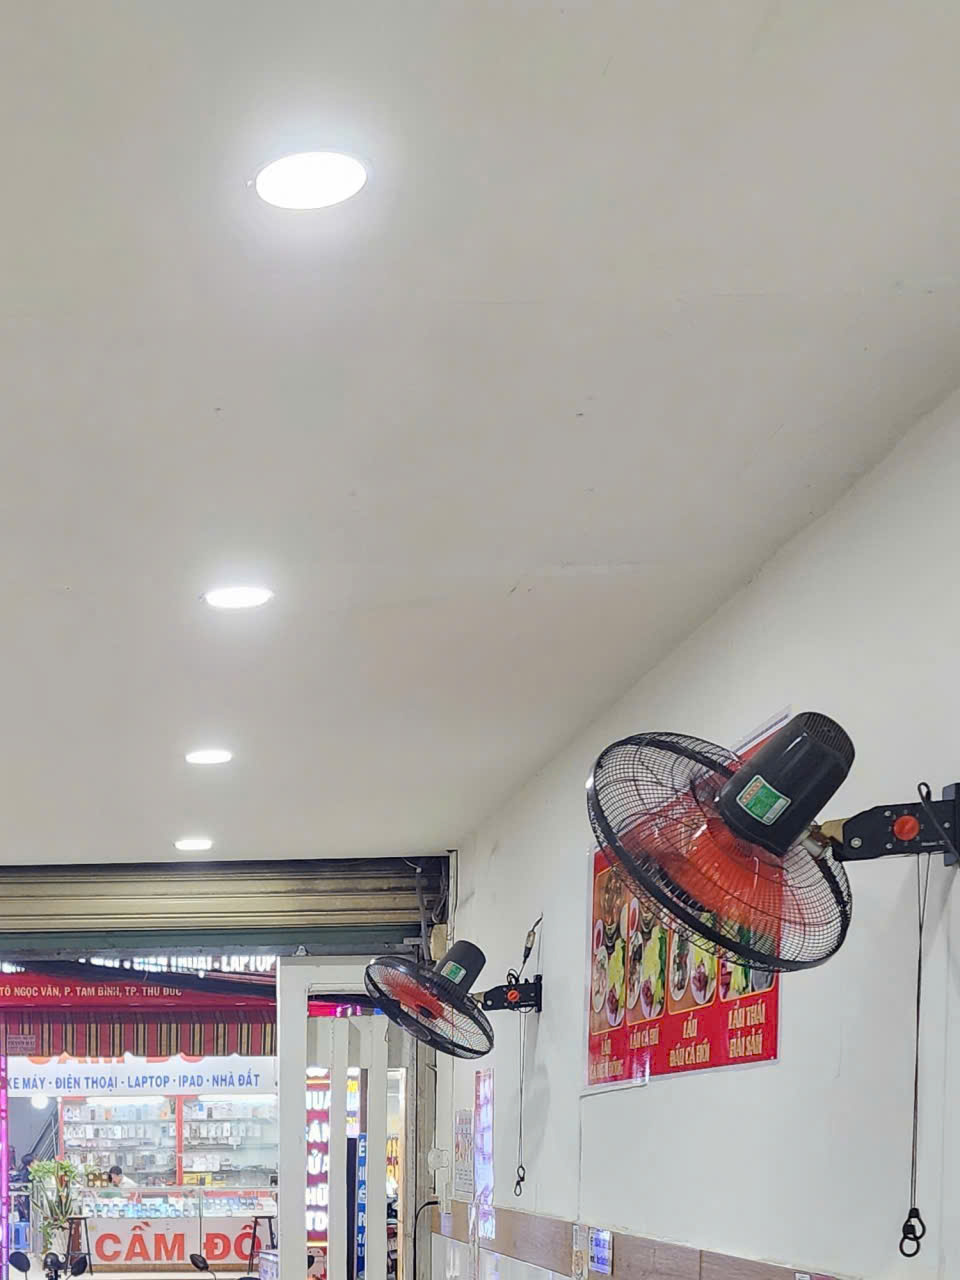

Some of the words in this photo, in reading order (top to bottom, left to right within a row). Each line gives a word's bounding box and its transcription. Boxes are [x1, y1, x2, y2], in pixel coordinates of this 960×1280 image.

[0, 984, 11, 996] TÔ
[14, 986, 38, 998] NGỌC
[64, 986, 73, 996] P.
[76, 986, 95, 996] TAM
[125, 986, 139, 996] TP.
[22, 1073, 46, 1090] MÁY
[55, 1073, 80, 1093] ĐIỆN
[84, 1076, 118, 1092] THOẠI
[127, 1075, 170, 1088] LAPTOP
[178, 1074, 204, 1088] IPAD
[212, 1071, 235, 1087] NHÀ
[238, 1067, 260, 1087] ĐẤT
[95, 1221, 185, 1262] CẦM
[203, 1219, 262, 1262] ĐỒ
